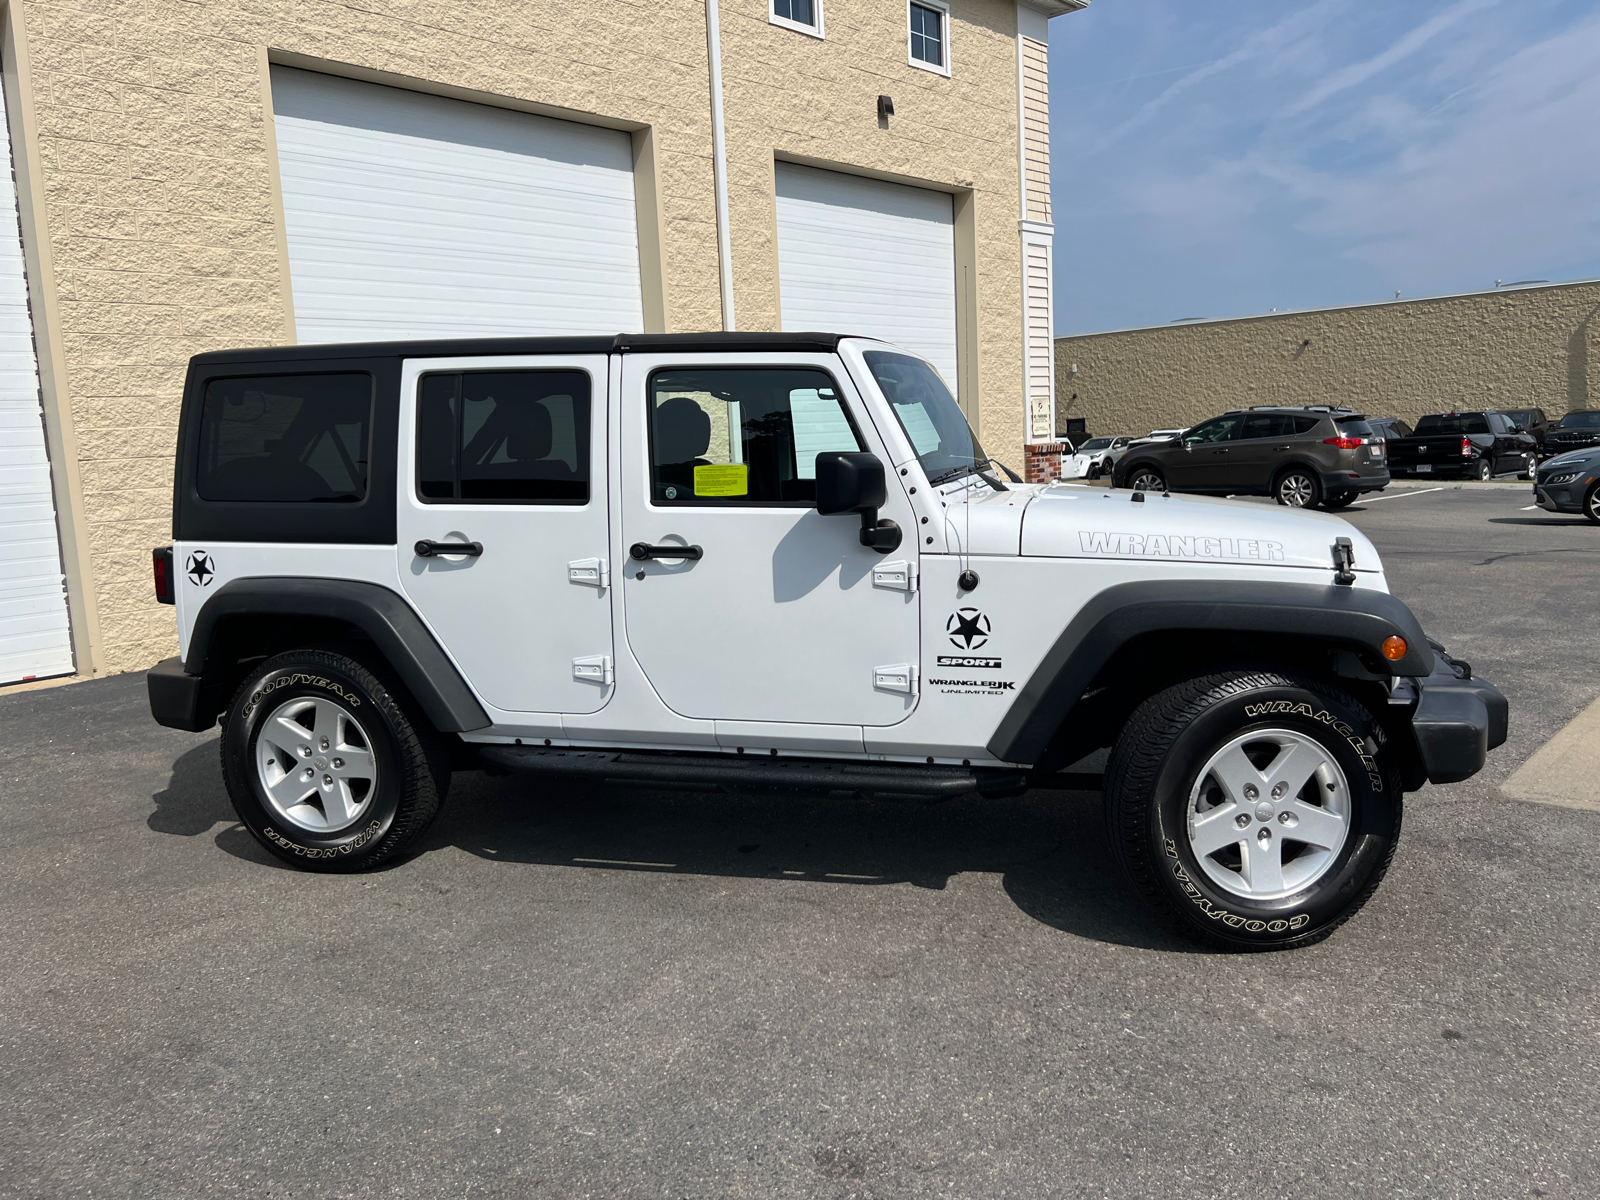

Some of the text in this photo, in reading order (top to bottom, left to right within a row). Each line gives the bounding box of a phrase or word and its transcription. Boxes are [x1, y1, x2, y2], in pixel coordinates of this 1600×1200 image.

[1078, 531, 1284, 561] WRANGLER
[939, 657, 1001, 667] SPORT
[242, 673, 361, 719] GOODYEAR
[1245, 700, 1383, 792] WRANGLER
[263, 820, 381, 858] WRANGLER
[1163, 838, 1310, 932] GOODYEAR
